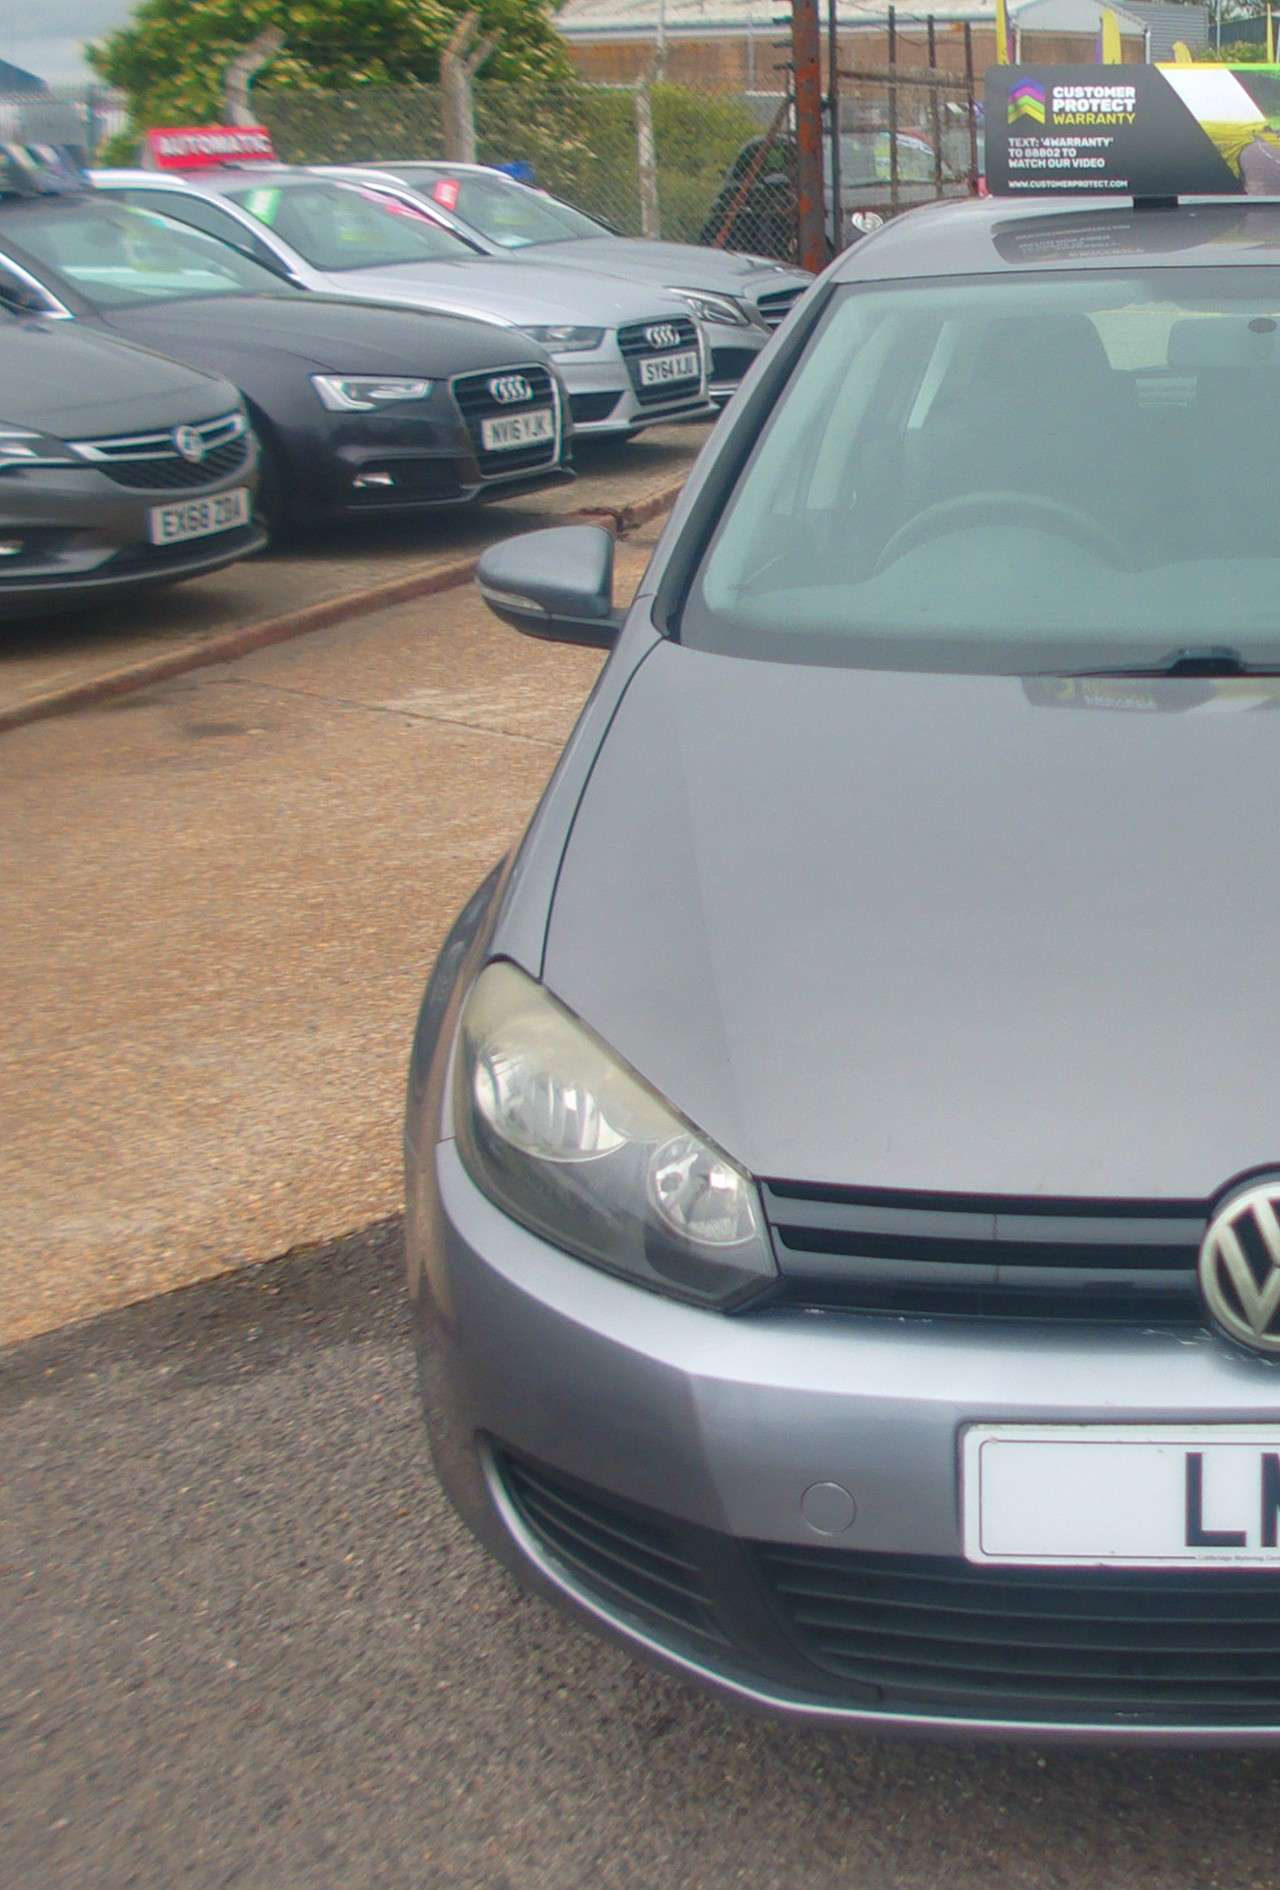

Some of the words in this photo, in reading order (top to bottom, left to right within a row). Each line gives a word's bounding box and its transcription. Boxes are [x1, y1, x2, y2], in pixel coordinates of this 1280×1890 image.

[1052, 86, 1136, 98] CUSTOMER
[1052, 99, 1136, 112] PROTECT
[1052, 113, 1136, 125] WARRANTY
[1008, 137, 1039, 147] TEXT:
[1008, 149, 1023, 157] TO
[1062, 149, 1077, 157] TO
[1008, 158, 1046, 168] WATCH
[1048, 158, 1071, 168] OUR
[1072, 158, 1106, 168] VIDEO
